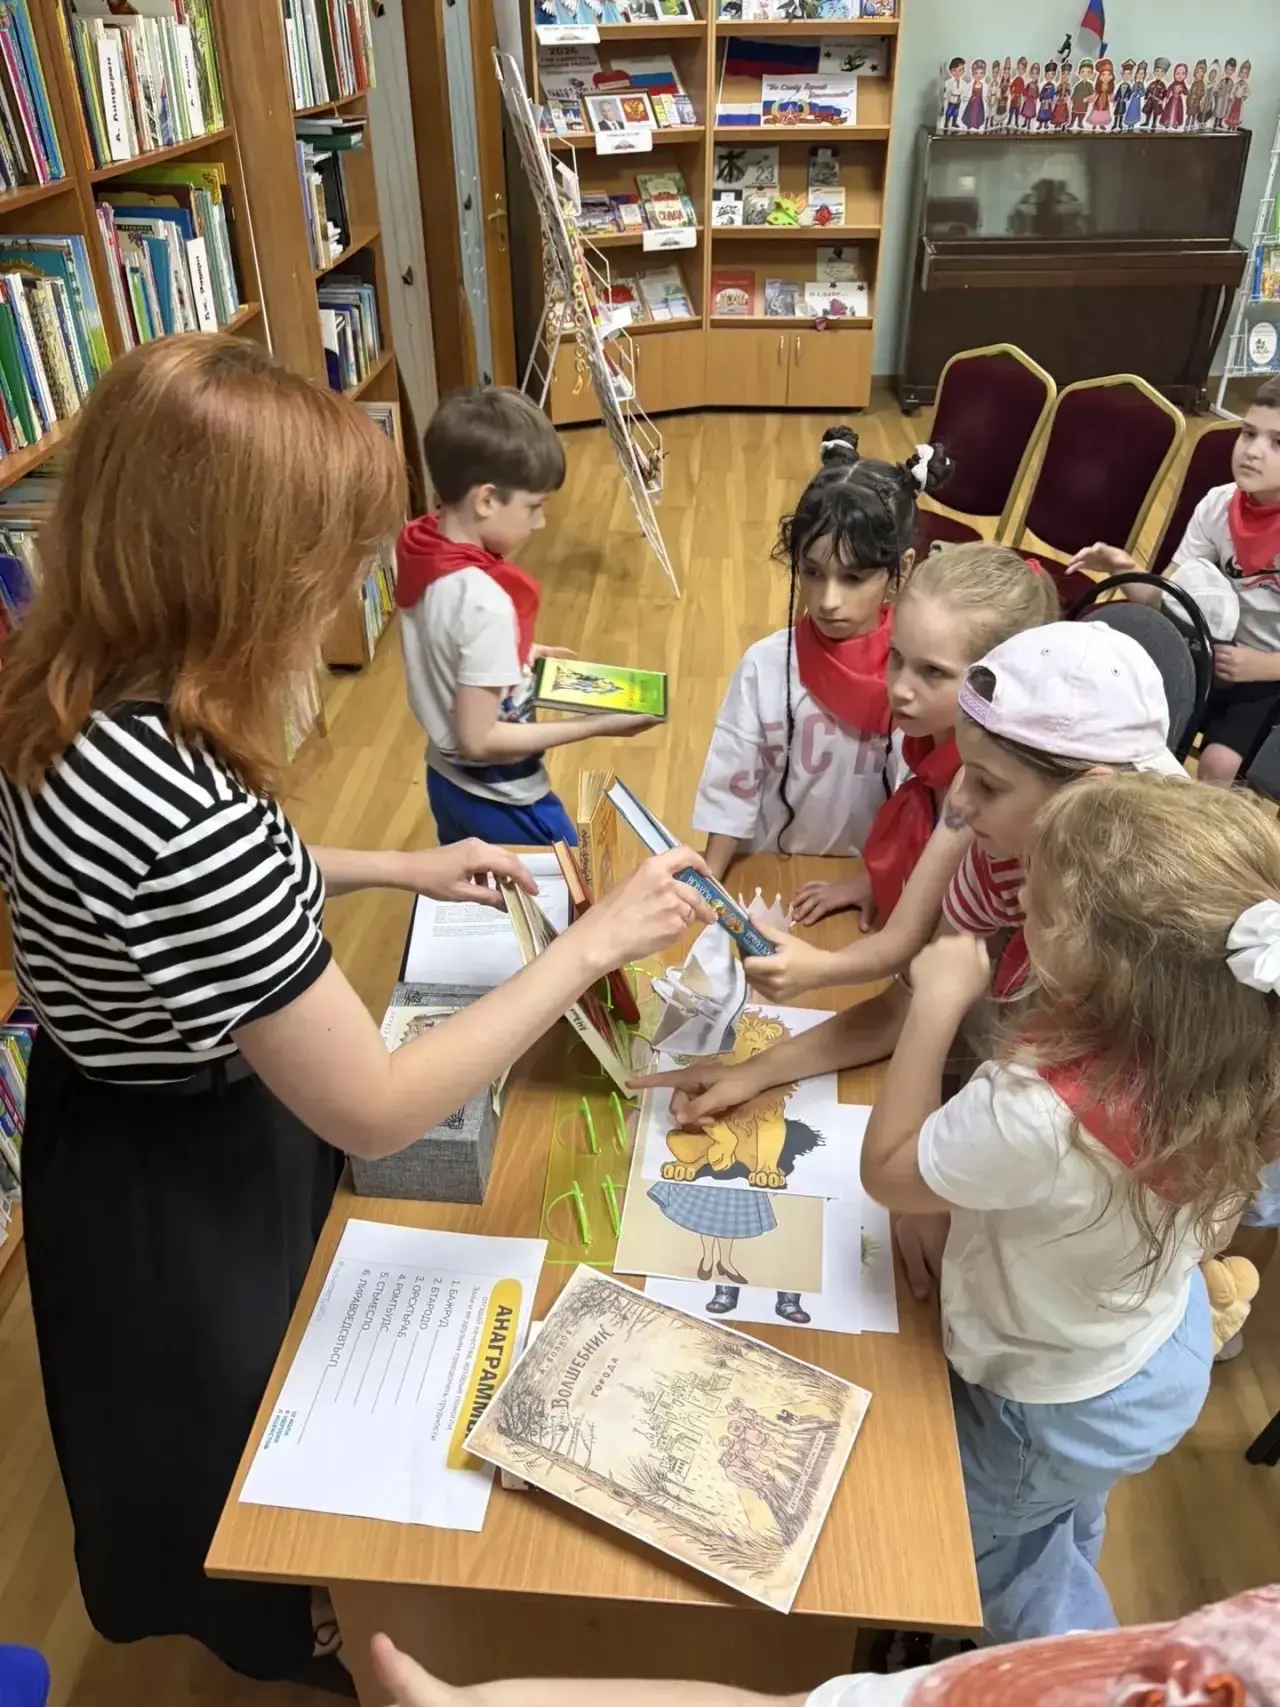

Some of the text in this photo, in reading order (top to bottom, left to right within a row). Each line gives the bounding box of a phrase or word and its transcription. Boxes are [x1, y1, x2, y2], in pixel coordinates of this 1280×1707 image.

[327, 1278, 367, 1368] ЛИРАВОЕДСВТЬСП
[360, 1281, 385, 1331] СТЬМЕСЛО
[378, 1282, 404, 1333] РОМТЬУДС
[397, 1283, 422, 1339] ОРСХТЬРАБ
[420, 1285, 441, 1330] БТАРОДО
[441, 1288, 459, 1328] БАЖРУД
[551, 1323, 614, 1408] ВОЛШЕБНИК
[589, 1355, 619, 1397] ГОРОДА
